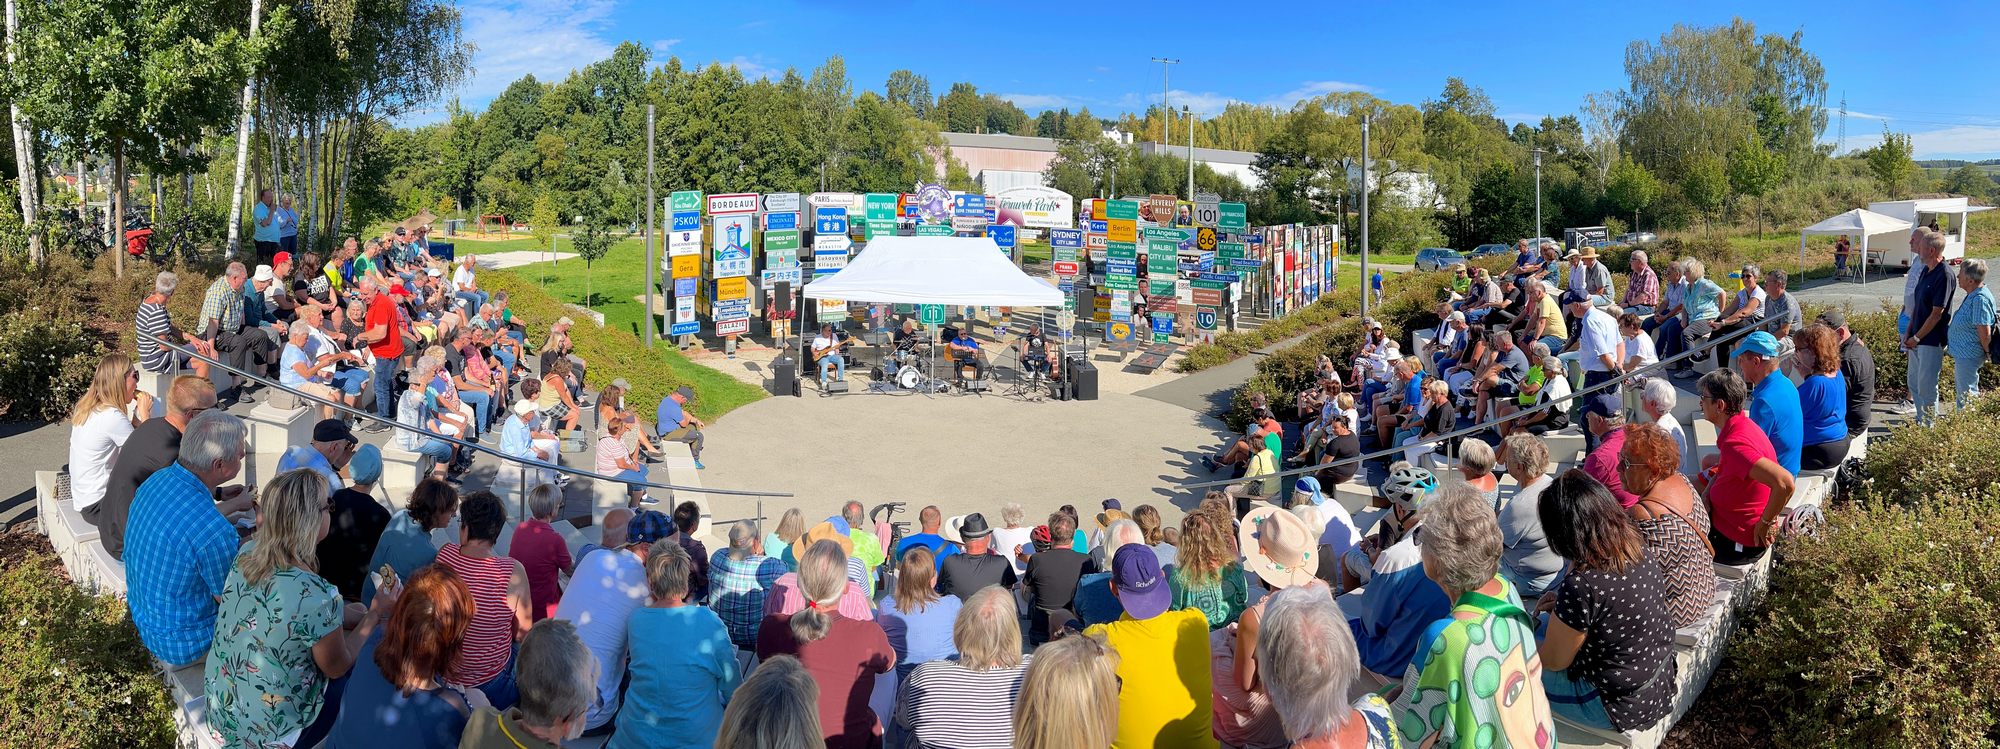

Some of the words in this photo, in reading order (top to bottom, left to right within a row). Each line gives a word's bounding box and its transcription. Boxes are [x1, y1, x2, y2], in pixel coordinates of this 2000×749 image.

[712, 200, 755, 210] BORDEAUX
[674, 216, 698, 226] PSKOV
[1198, 210, 1216, 222] 101
[823, 222, 840, 232] 香港
[1052, 230, 1080, 240] SYDNEY
[1156, 230, 1180, 238] Angeles
[1200, 233, 1214, 245] 66
[1152, 244, 1173, 252] MALIBU
[720, 288, 744, 296] München
[1200, 314, 1213, 325] 10
[674, 325, 699, 333] Arnhem
[720, 322, 745, 330] SALAZIE
